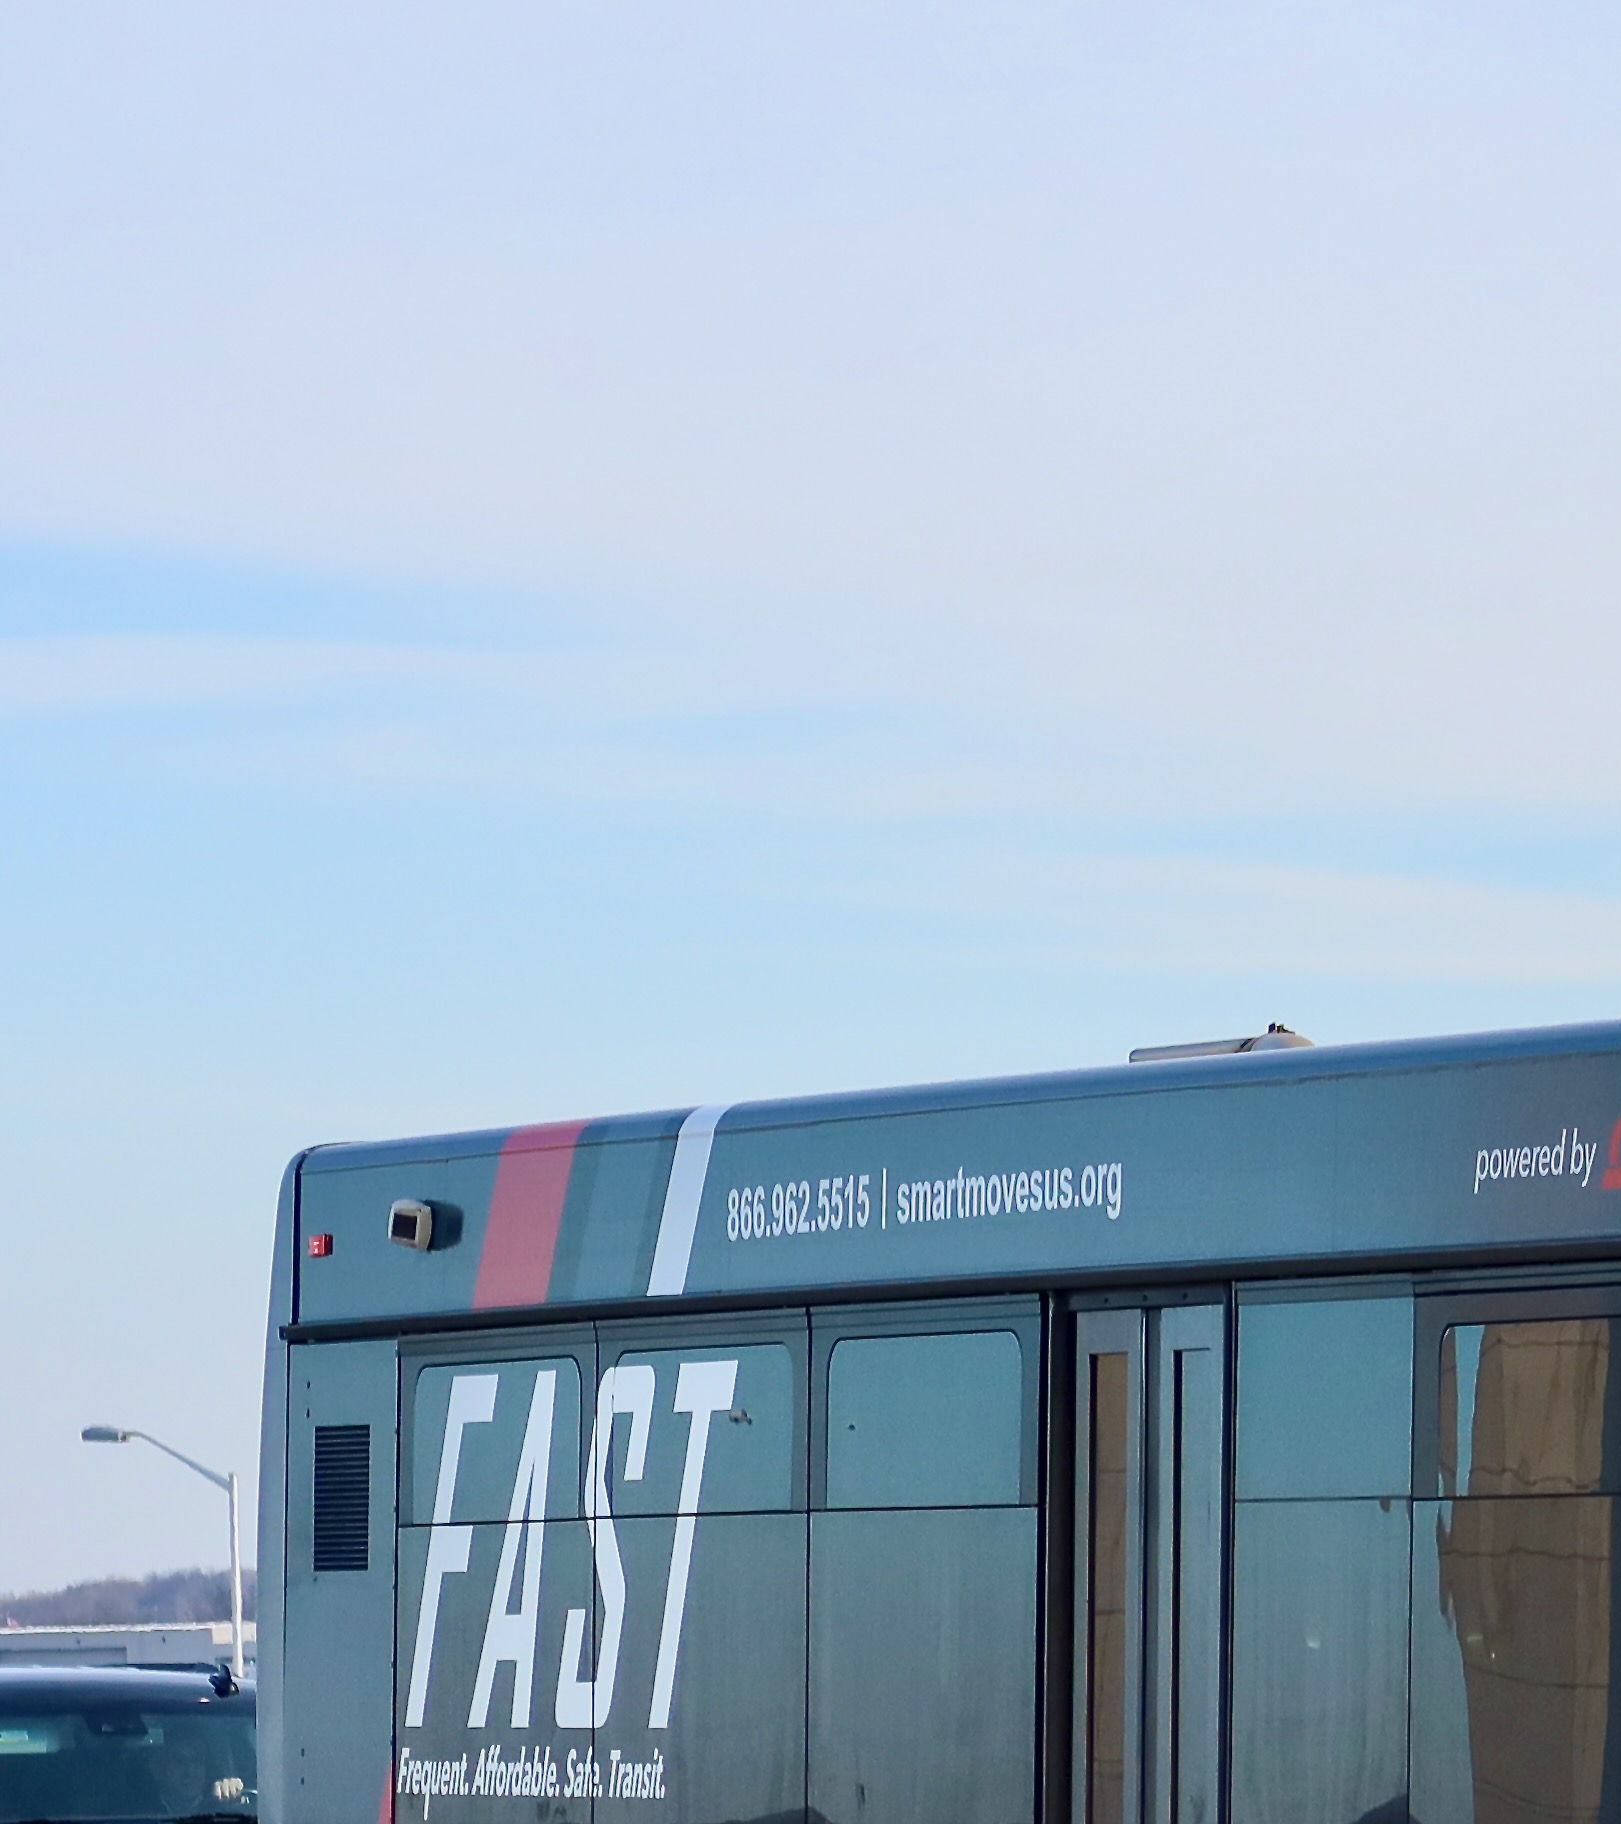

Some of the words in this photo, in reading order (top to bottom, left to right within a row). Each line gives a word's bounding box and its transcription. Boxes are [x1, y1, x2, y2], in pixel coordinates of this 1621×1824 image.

[1473, 1127, 1568, 1195] powered
[1569, 1127, 1597, 1188] by
[726, 1173, 870, 1242] 866.962.5515
[896, 1162, 1123, 1221] smartmovesus.org
[404, 1359, 739, 1729] FAST
[396, 1747, 469, 1821] Frequent.
[470, 1744, 560, 1797] Affordable.
[563, 1745, 603, 1798] Safe.
[608, 1747, 666, 1800] Transit.
